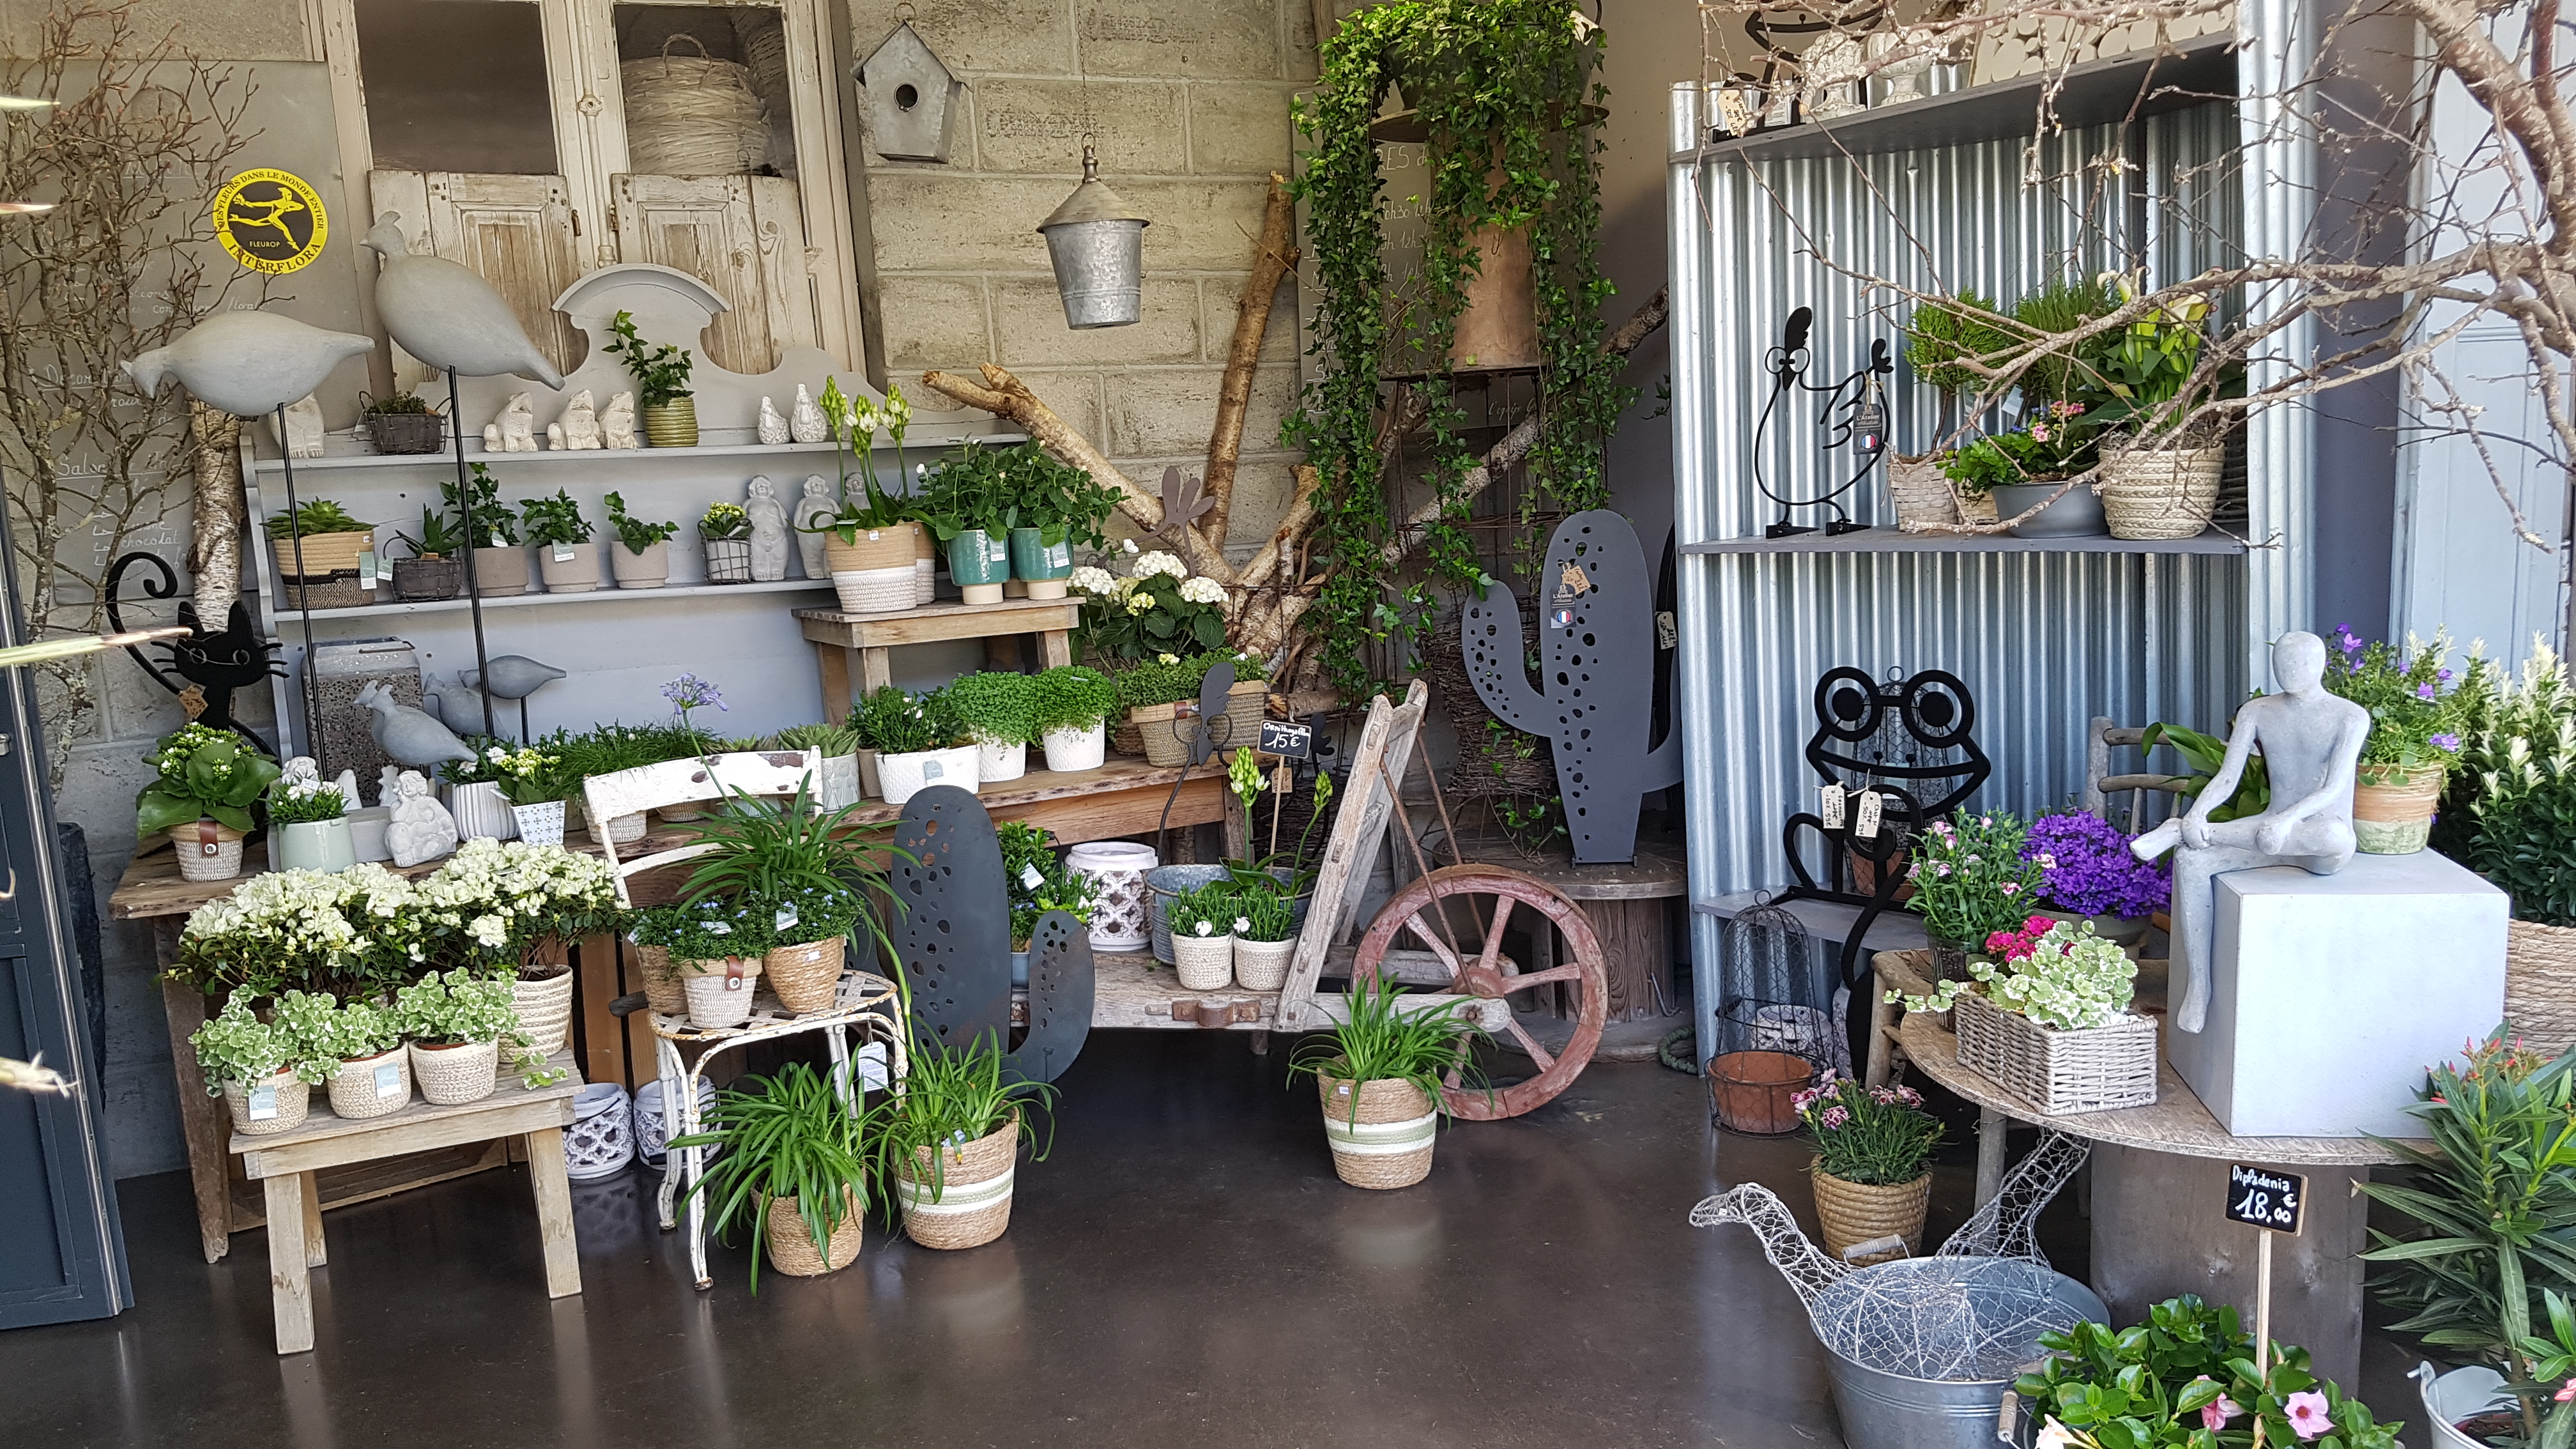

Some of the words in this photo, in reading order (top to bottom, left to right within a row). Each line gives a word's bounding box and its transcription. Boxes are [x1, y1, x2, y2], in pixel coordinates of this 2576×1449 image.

[218, 179, 241, 209] FLEURS
[240, 171, 265, 183] DANS
[266, 171, 279, 179] LE
[280, 174, 311, 198] MONDE
[309, 195, 325, 230] ENTIER
[227, 243, 321, 272] INTERFLORA
[249, 240, 281, 249] FLEUROP
[121, 529, 182, 549] chocolat
[2232, 1165, 2290, 1192] Dipladenia
